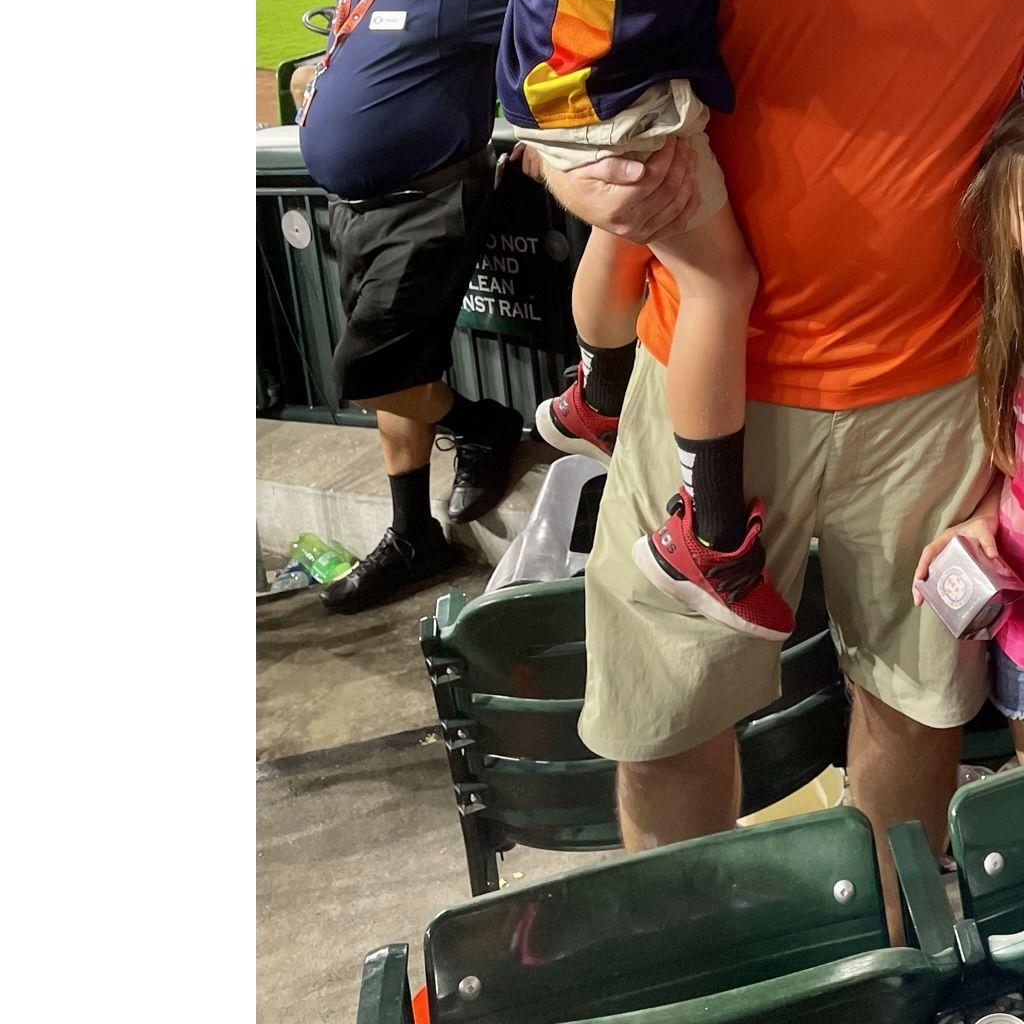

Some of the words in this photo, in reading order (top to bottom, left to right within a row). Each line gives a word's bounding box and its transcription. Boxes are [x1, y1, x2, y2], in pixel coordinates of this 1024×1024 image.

[501, 234, 539, 255] NOT
[460, 294, 495, 315] NST
[499, 299, 542, 321] RAIL
